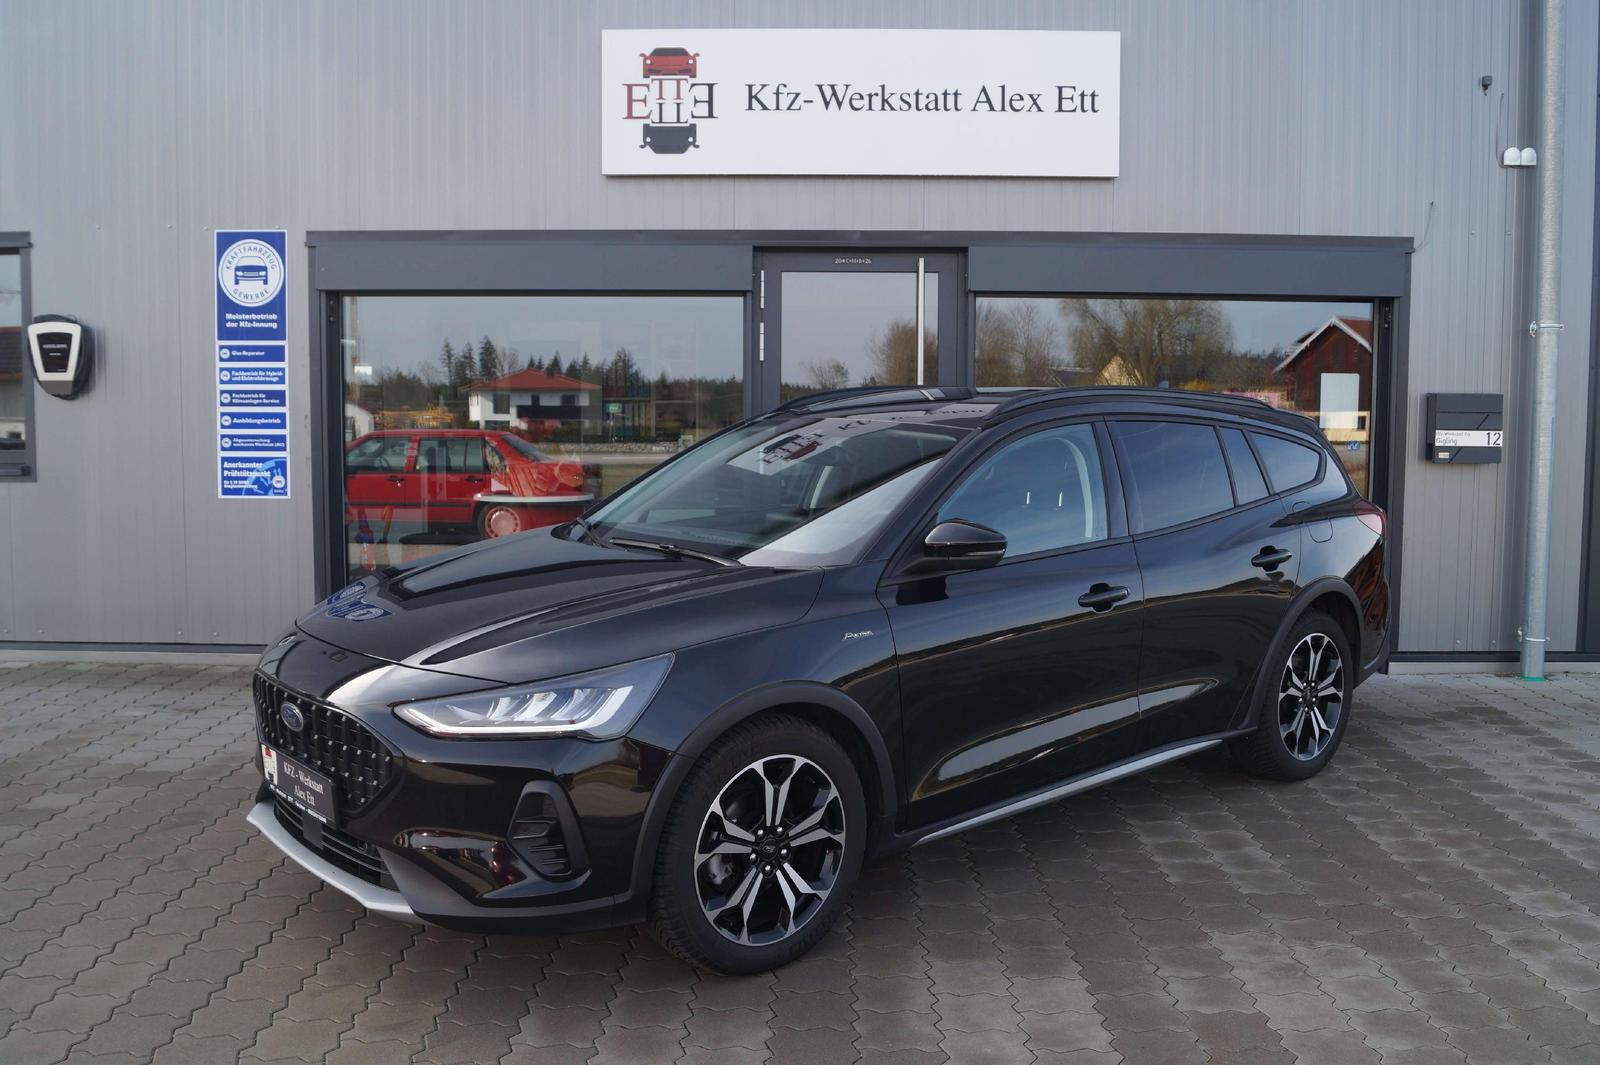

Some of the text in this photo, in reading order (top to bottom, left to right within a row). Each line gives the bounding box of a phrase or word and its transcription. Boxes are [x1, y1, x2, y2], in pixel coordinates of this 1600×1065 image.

[744, 83, 1100, 114] Kfz-Werkstatt Alex Ett
[239, 321, 278, 329] Kfz-Innung
[1486, 432, 1501, 446] 12
